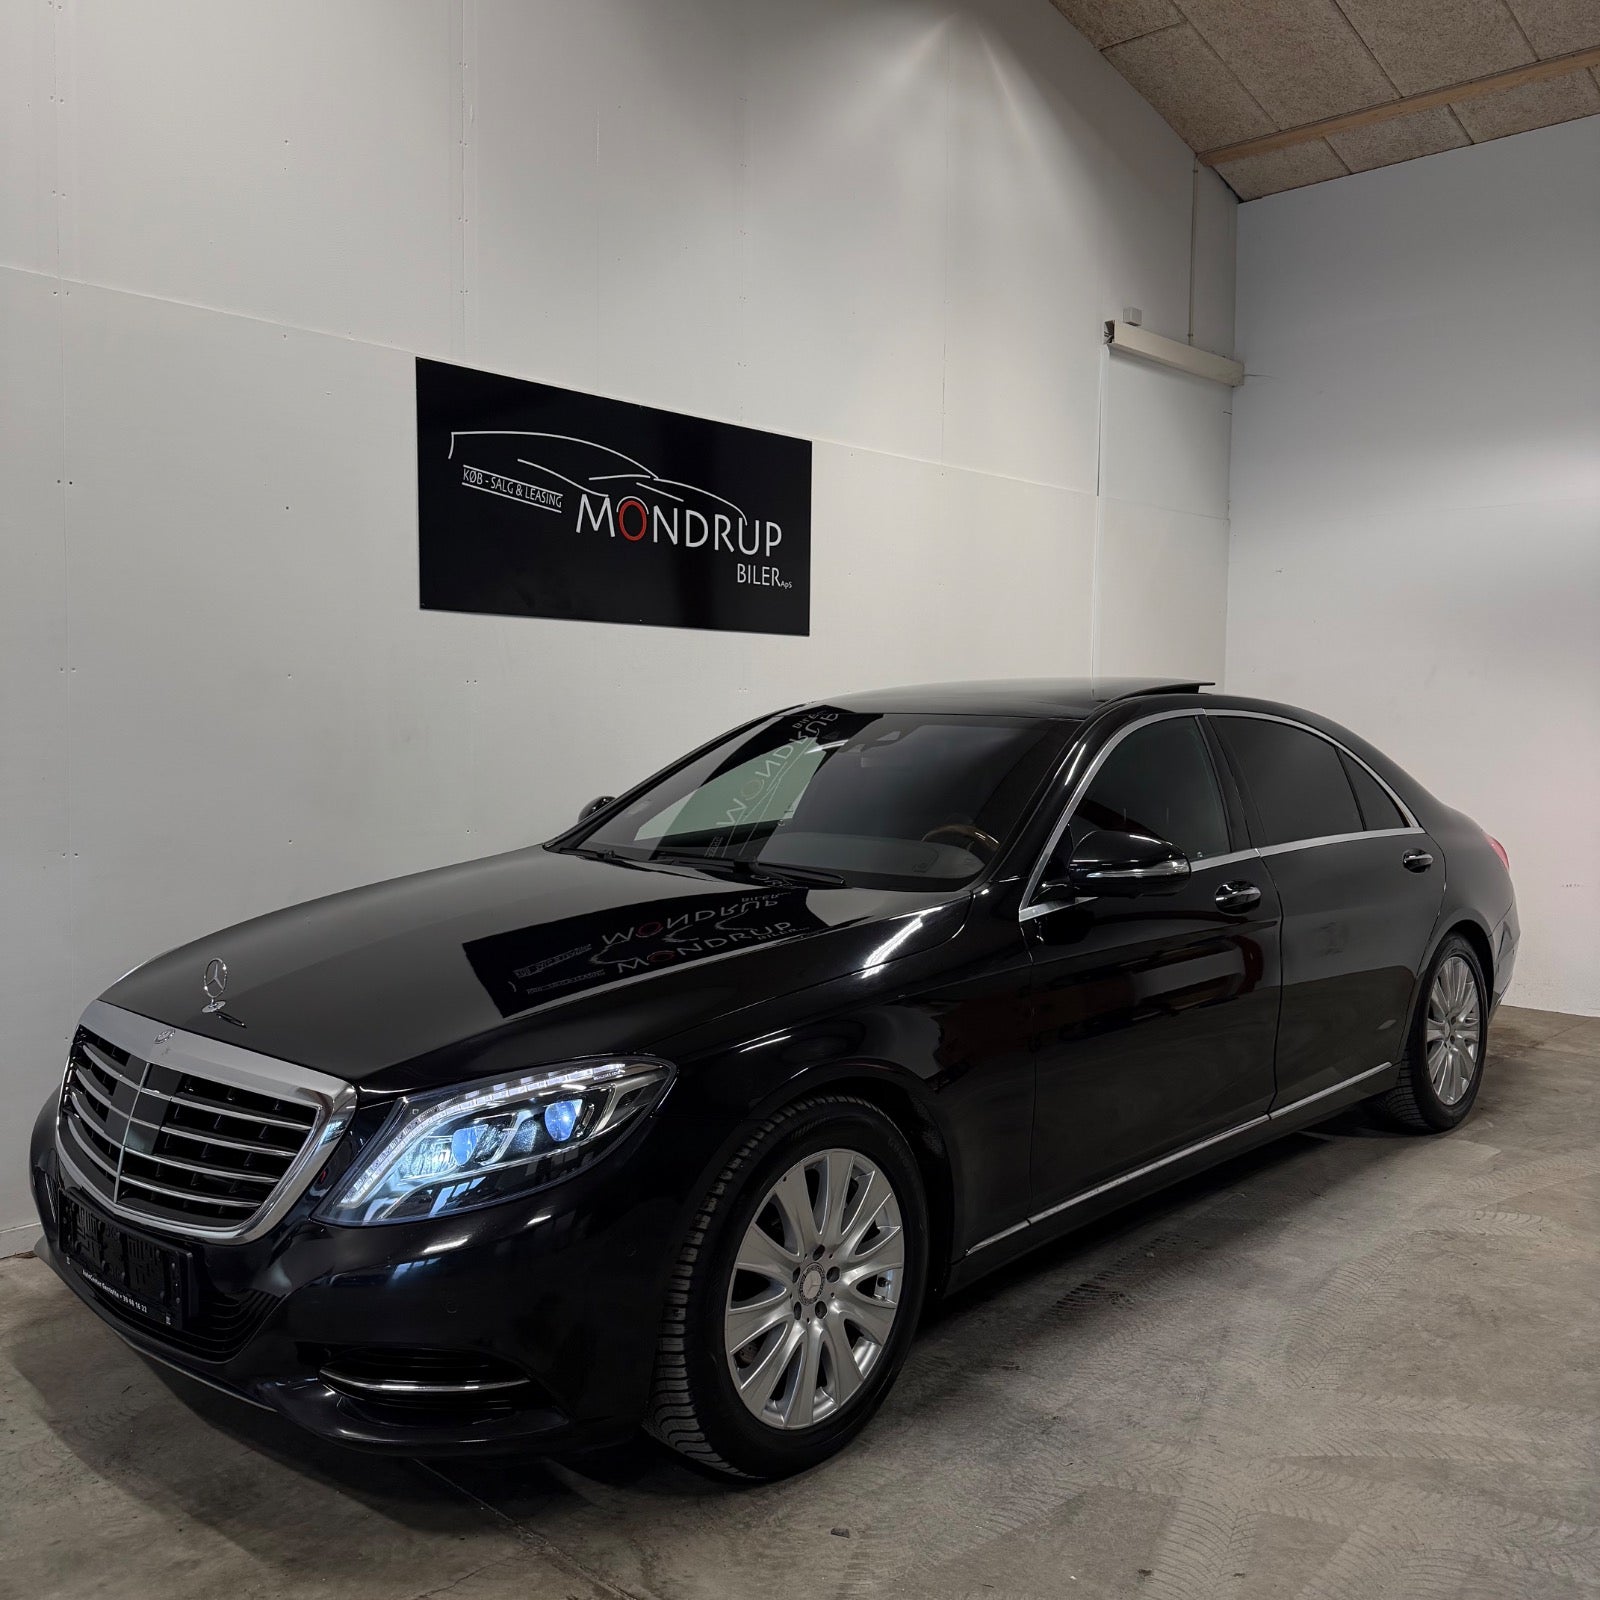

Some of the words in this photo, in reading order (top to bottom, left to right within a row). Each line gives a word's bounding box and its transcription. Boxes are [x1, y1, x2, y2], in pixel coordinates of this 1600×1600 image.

[463, 468, 483, 484] KØB
[491, 476, 514, 494] SALG
[515, 483, 523, 497] &
[525, 486, 562, 508] LEASING
[576, 493, 782, 557] MONDRUP
[737, 563, 780, 587] BILER
[617, 921, 791, 974] MONDRUP
